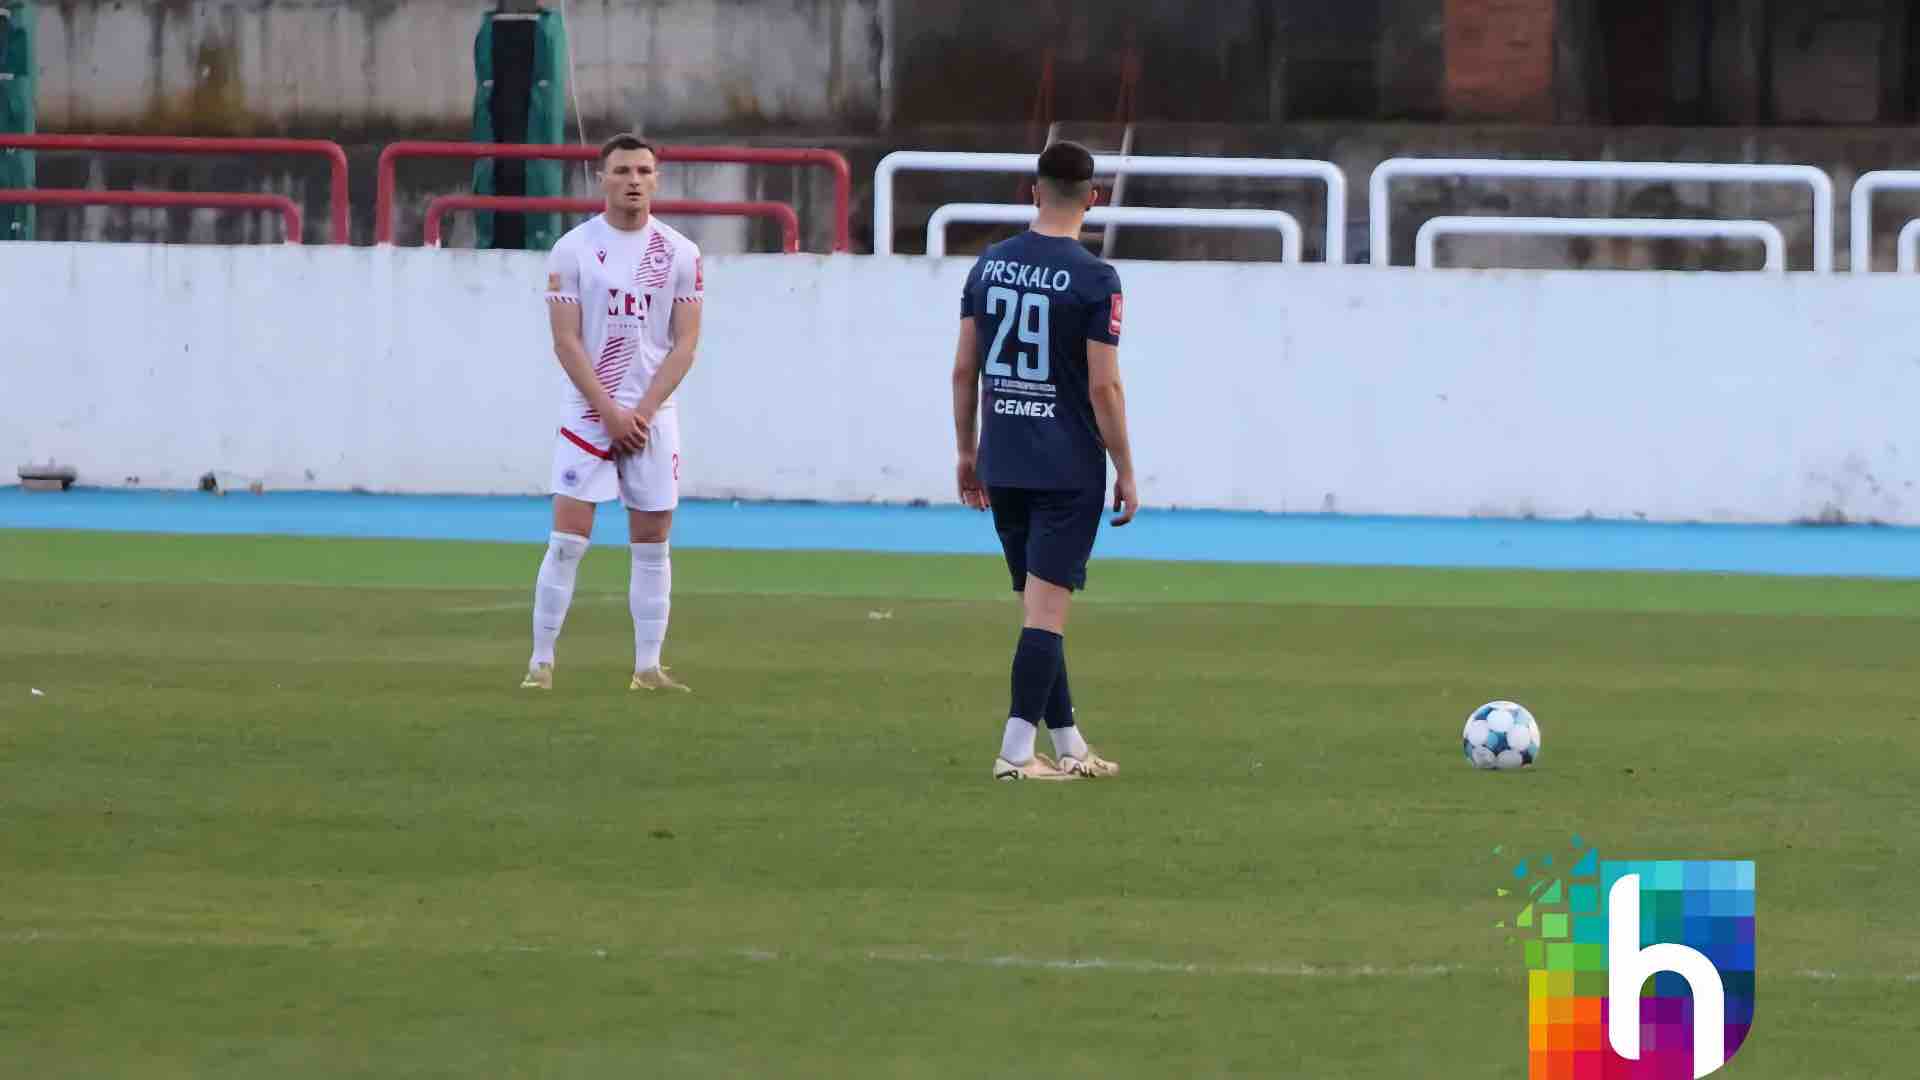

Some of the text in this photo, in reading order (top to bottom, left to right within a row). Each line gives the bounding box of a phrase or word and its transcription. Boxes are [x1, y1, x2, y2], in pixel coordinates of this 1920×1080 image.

[981, 260, 1071, 291] PRSKALO
[985, 286, 1050, 381] 29
[994, 399, 1056, 418] CEMEX
